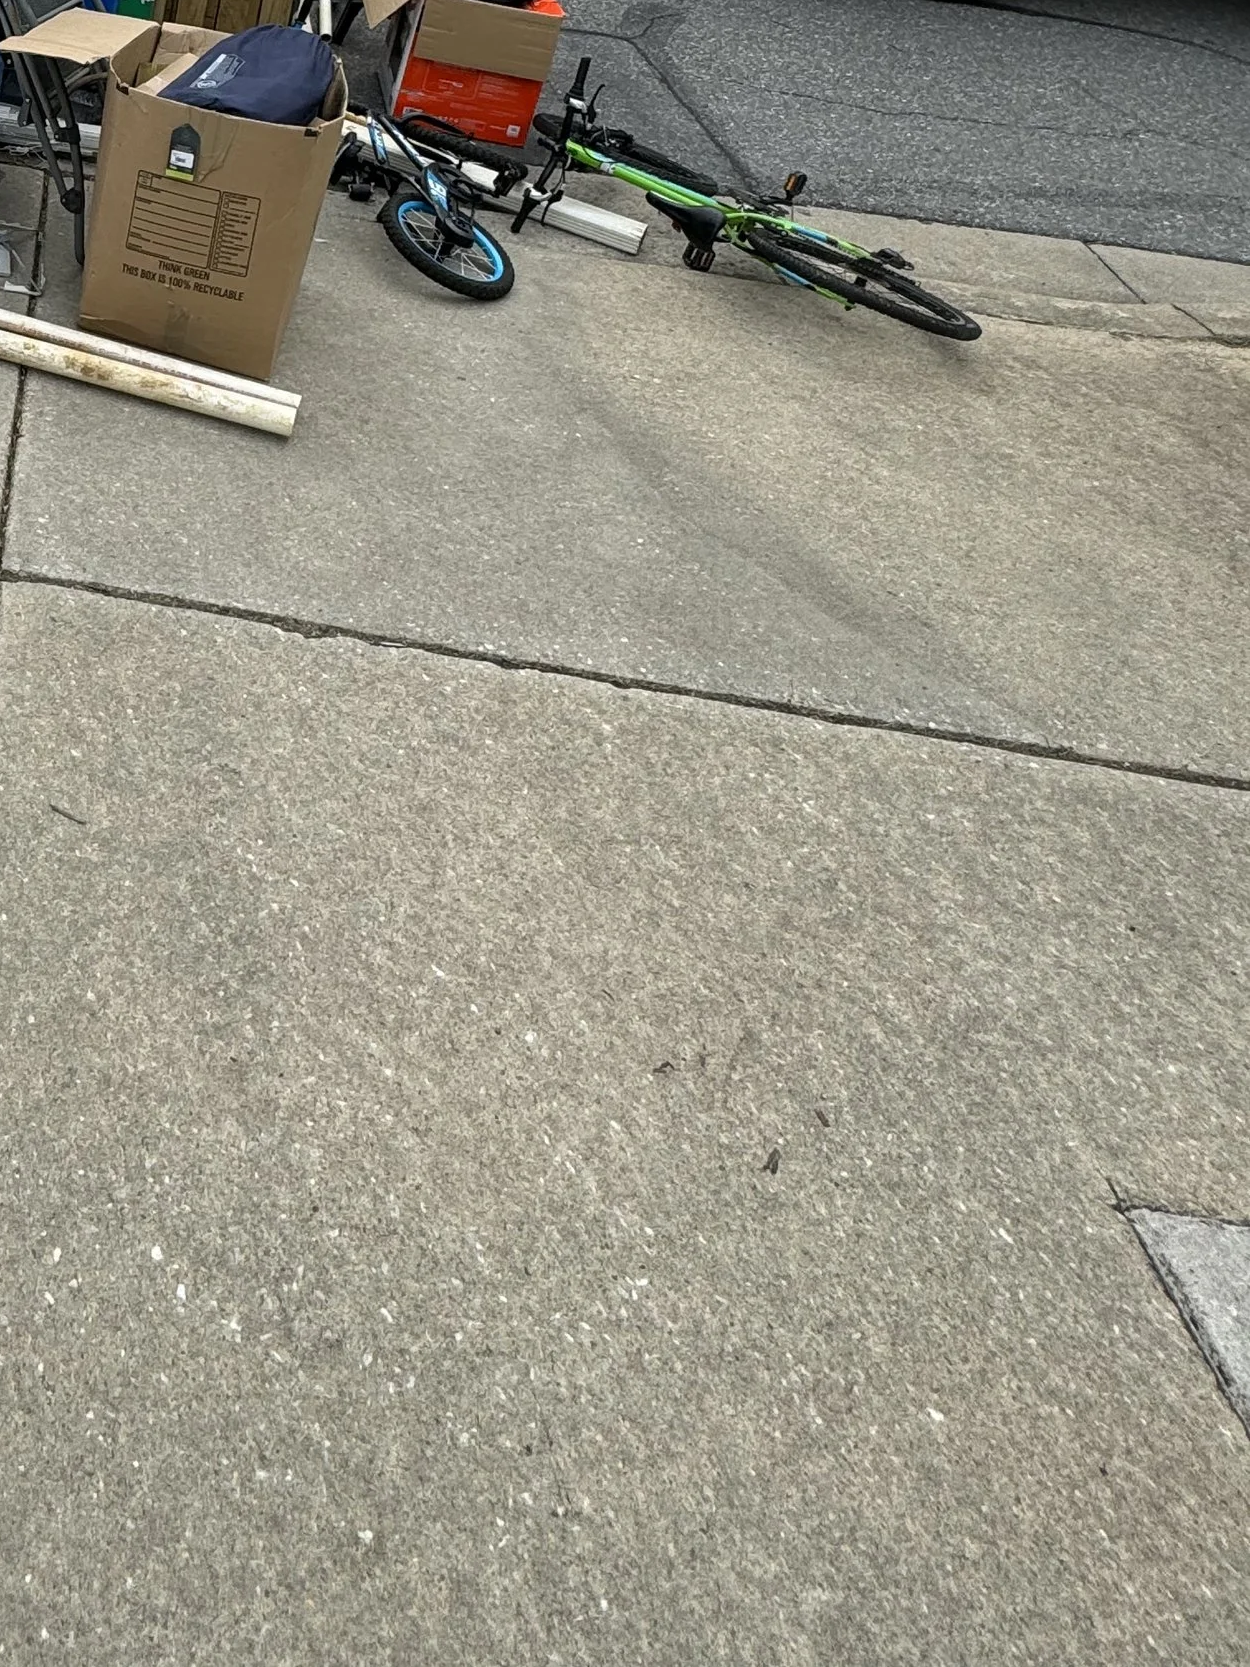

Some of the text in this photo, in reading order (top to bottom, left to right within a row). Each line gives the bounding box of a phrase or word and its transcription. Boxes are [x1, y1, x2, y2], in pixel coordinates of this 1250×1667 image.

[122, 263, 245, 302] THIS BOX IS 100% RECYCLABLE
[158, 260, 210, 281] THINK GREEN
